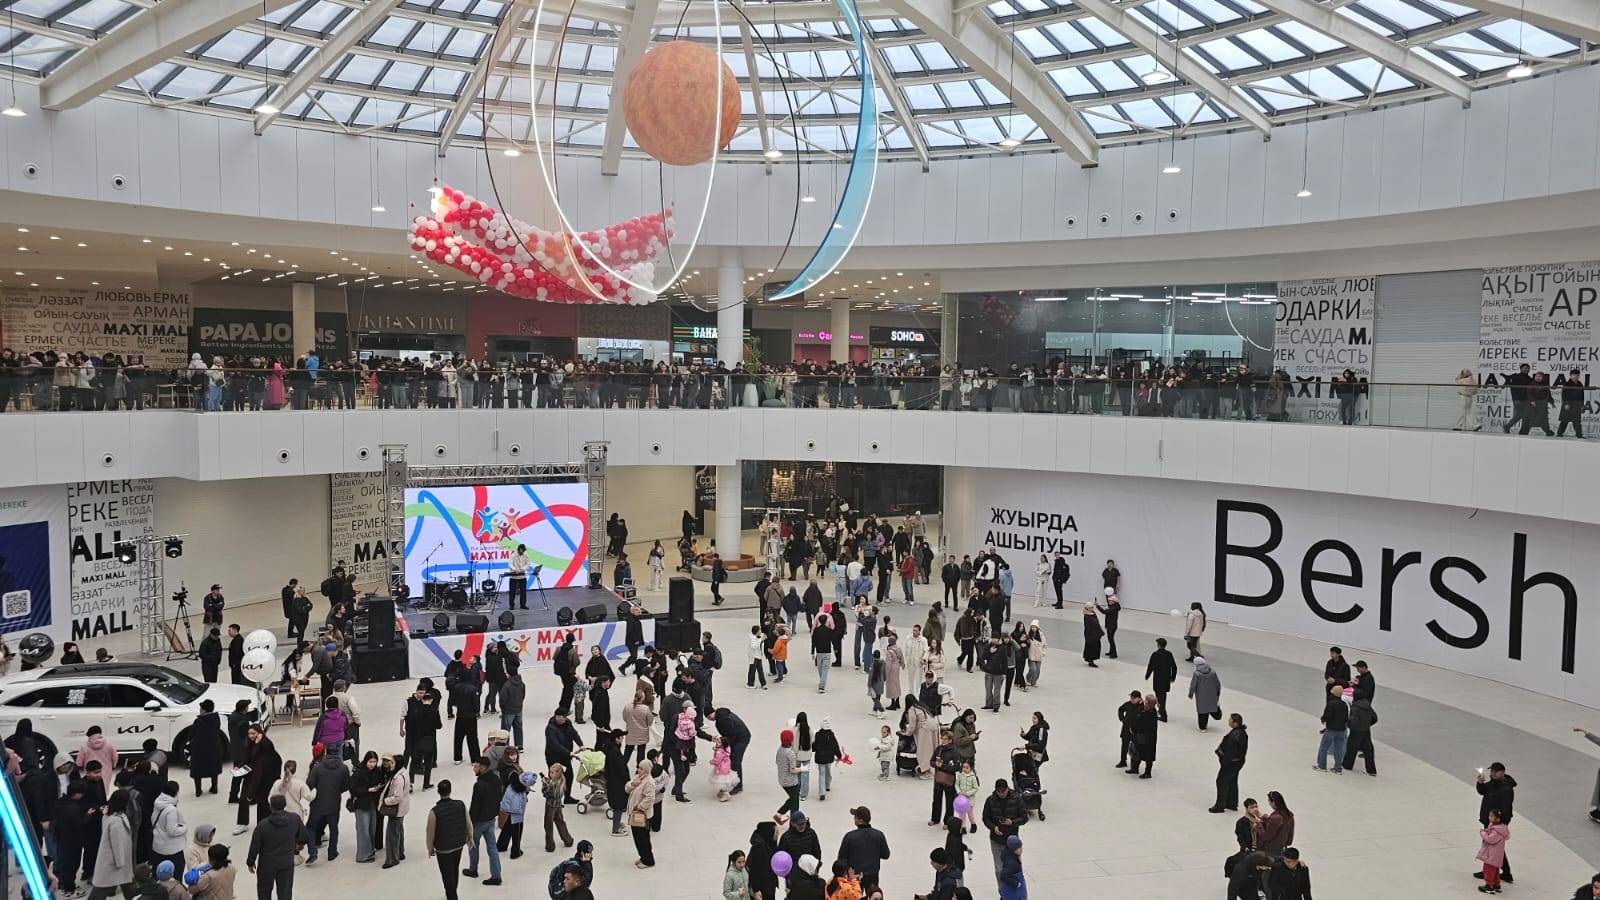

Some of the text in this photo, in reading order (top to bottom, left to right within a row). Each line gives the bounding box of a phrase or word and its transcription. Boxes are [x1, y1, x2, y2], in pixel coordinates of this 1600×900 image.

[38, 295, 85, 306] ЛӘЗЗАТ
[95, 291, 151, 302] ЛЮБОВЬ
[1548, 287, 1597, 317] АР
[133, 305, 190, 318] АРМАН
[53, 321, 101, 335] САУДА
[103, 323, 147, 336] MAXI
[1544, 320, 1592, 331] СЧАСТЬЕ
[200, 322, 337, 343] PAPA JONS
[891, 331, 915, 341] SOHO
[1290, 328, 1345, 347] САУДА
[24, 335, 63, 345] ЕРМЕК
[67, 336, 127, 347] СЧАСТЬЕ
[137, 336, 176, 346] МЕРЕКЕ
[1537, 347, 1600, 361] ЕРМЕК
[351, 517, 388, 531] ЕРМЕК
[991, 506, 1079, 534] ЖУЫРДА
[984, 529, 1086, 558] АШЫЛУЫ!
[470, 550, 498, 561] MAXI
[81, 574, 104, 585] MAXI
[105, 570, 127, 580] MALL
[1213, 498, 1578, 675] Bersh
[71, 610, 133, 641] MALL
[117, 724, 155, 735] KIA
